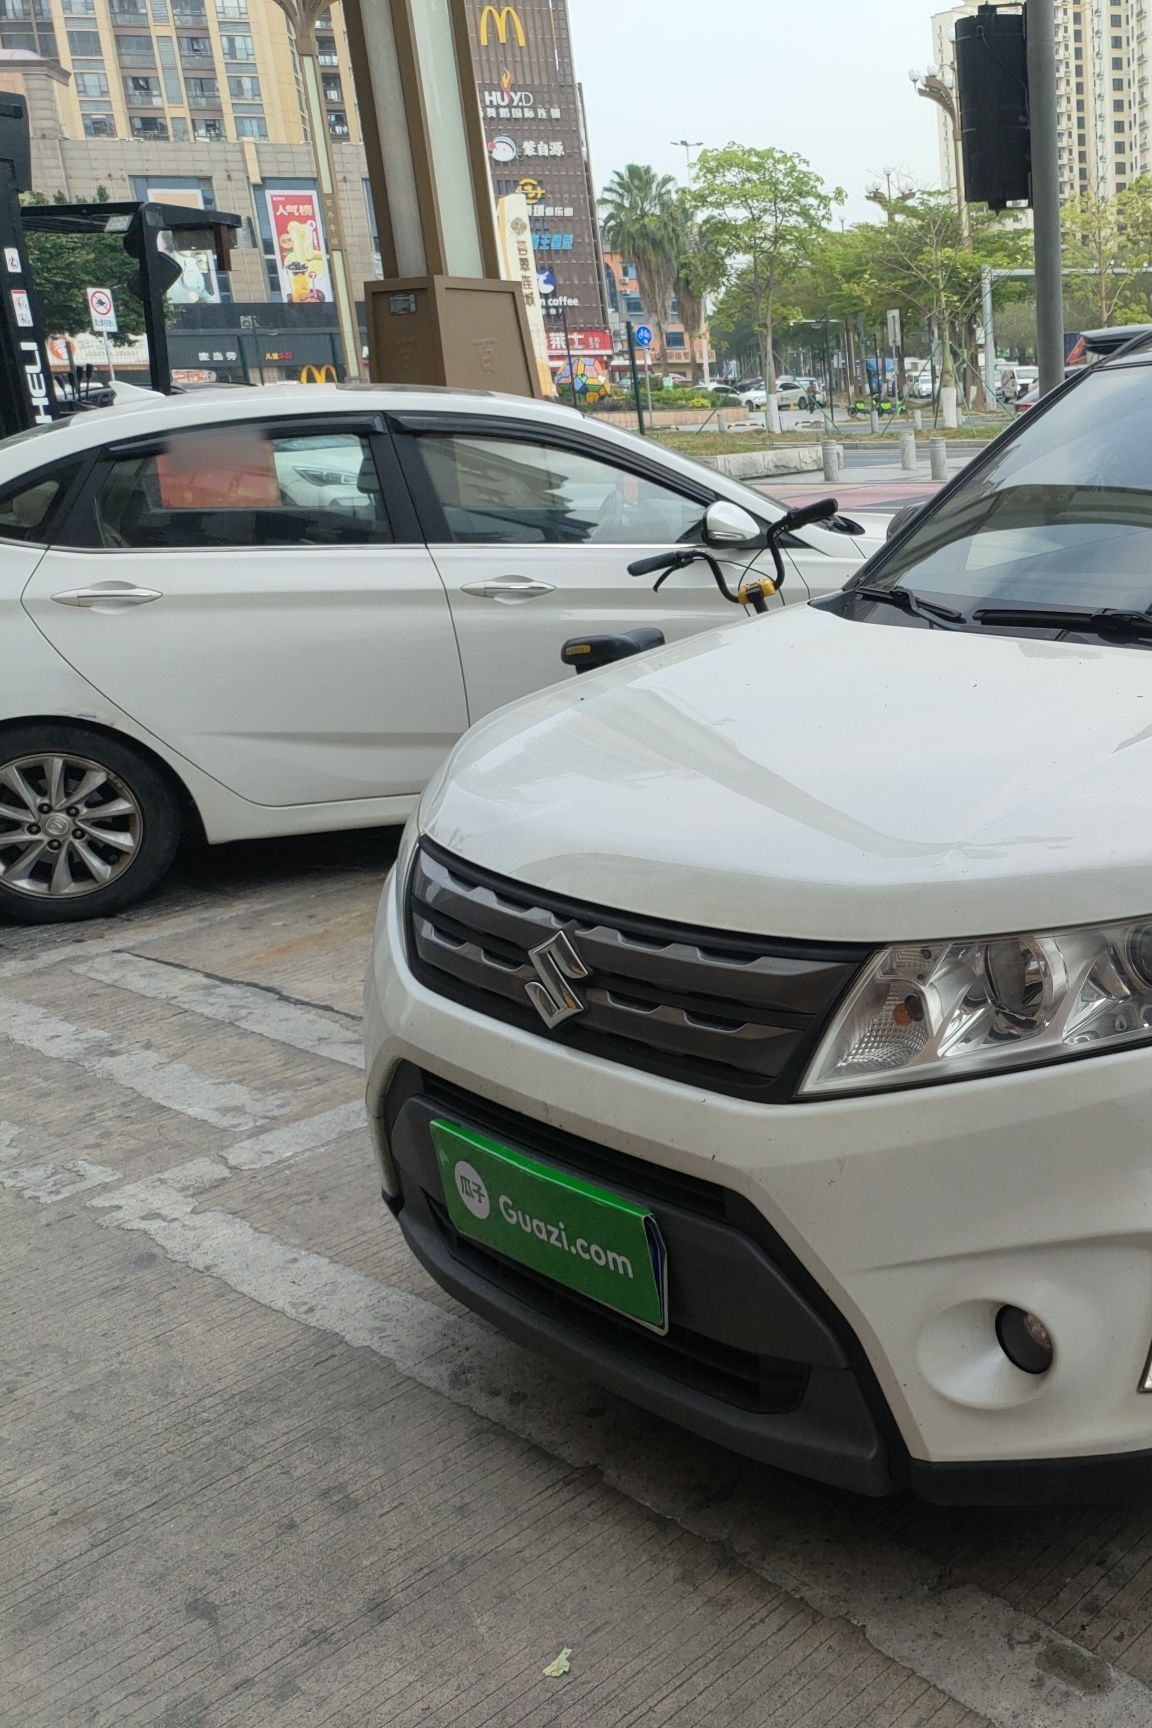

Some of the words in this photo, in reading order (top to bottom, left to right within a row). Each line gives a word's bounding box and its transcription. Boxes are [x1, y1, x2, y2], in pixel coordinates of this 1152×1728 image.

[548, 296, 579, 306] coffee
[546, 331, 584, 350] 莱士
[20, 341, 52, 424] HELI
[460, 1174, 486, 1204] 瓜子
[499, 1194, 634, 1279] Guazi.com
